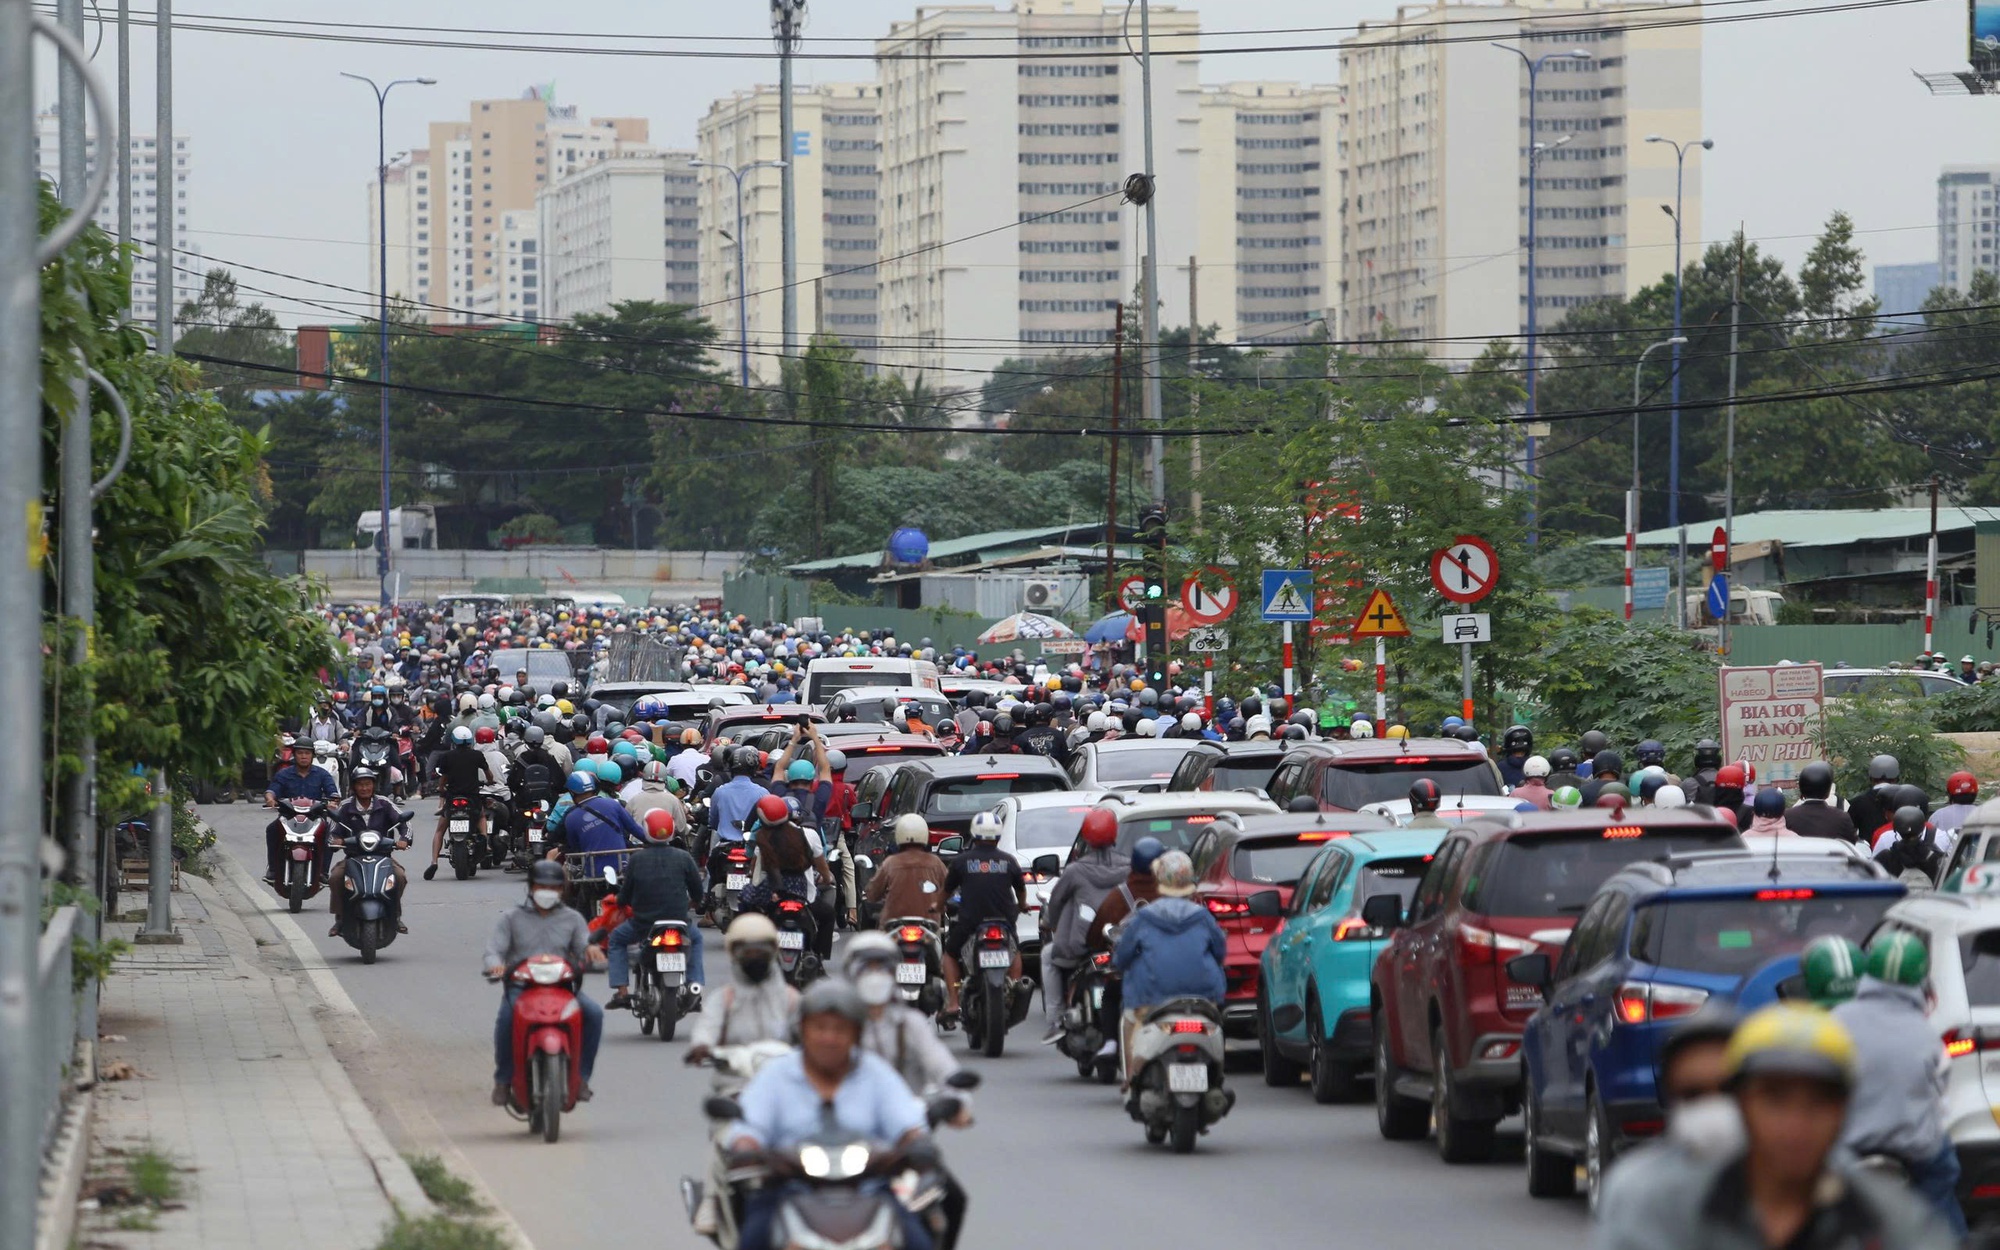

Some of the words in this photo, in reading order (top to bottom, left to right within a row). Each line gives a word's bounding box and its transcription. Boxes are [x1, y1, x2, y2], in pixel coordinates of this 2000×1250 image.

[793, 132, 811, 155] E
[1731, 689, 1766, 697] HABECO
[1740, 705, 1770, 719] BIA
[1772, 703, 1806, 718] HƠI
[1743, 720, 1770, 738] HÀ
[1772, 719, 1805, 739] NỘI
[1737, 744, 1768, 761] AN
[1773, 739, 1813, 760] PHÚ
[967, 859, 1007, 873] Mobil
